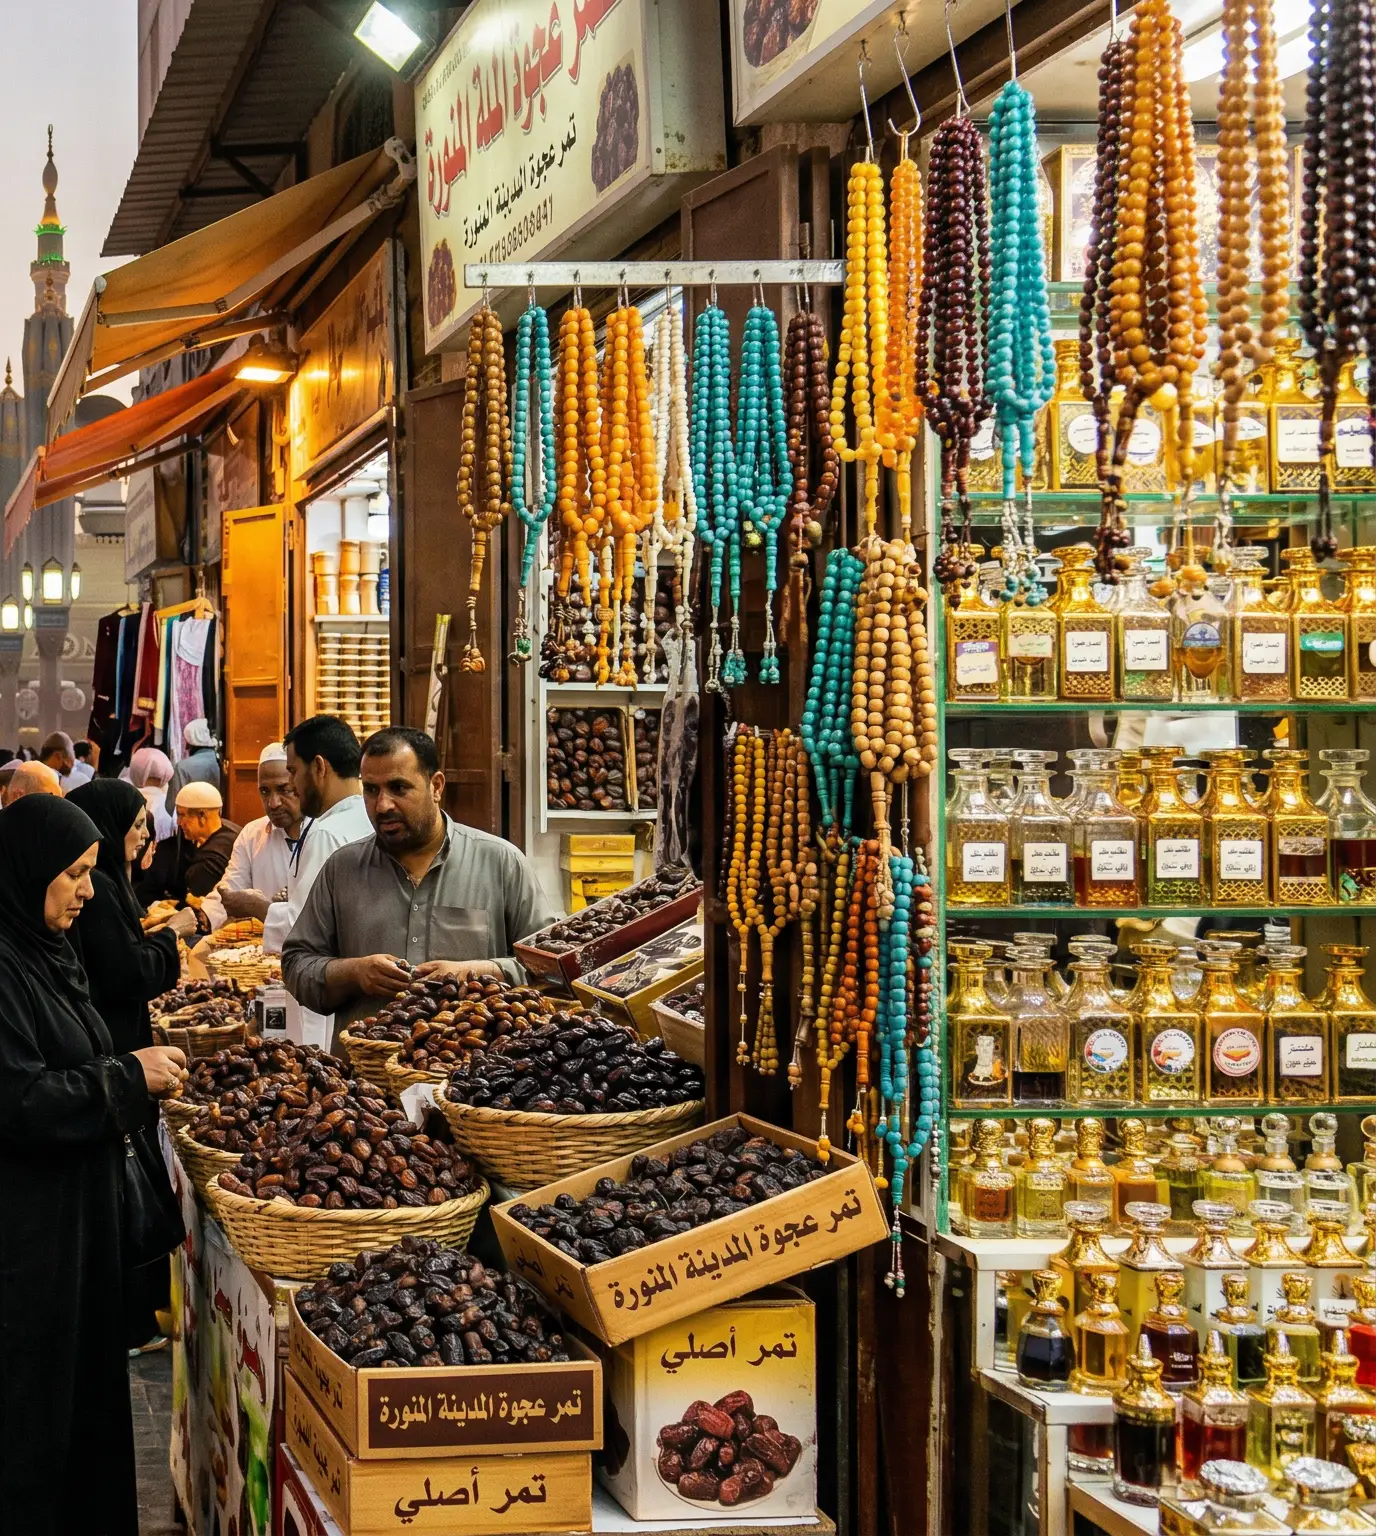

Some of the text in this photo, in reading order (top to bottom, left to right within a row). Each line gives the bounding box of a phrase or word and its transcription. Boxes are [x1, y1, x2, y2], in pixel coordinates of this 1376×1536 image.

[607, 1188, 863, 1311] تمر عجوة المدينة المنورة
[660, 1325, 798, 1374] تمر أصلي
[379, 1389, 582, 1430] تمر عجوة المدينة المنورة
[393, 1465, 547, 1525] تمر أصلي
